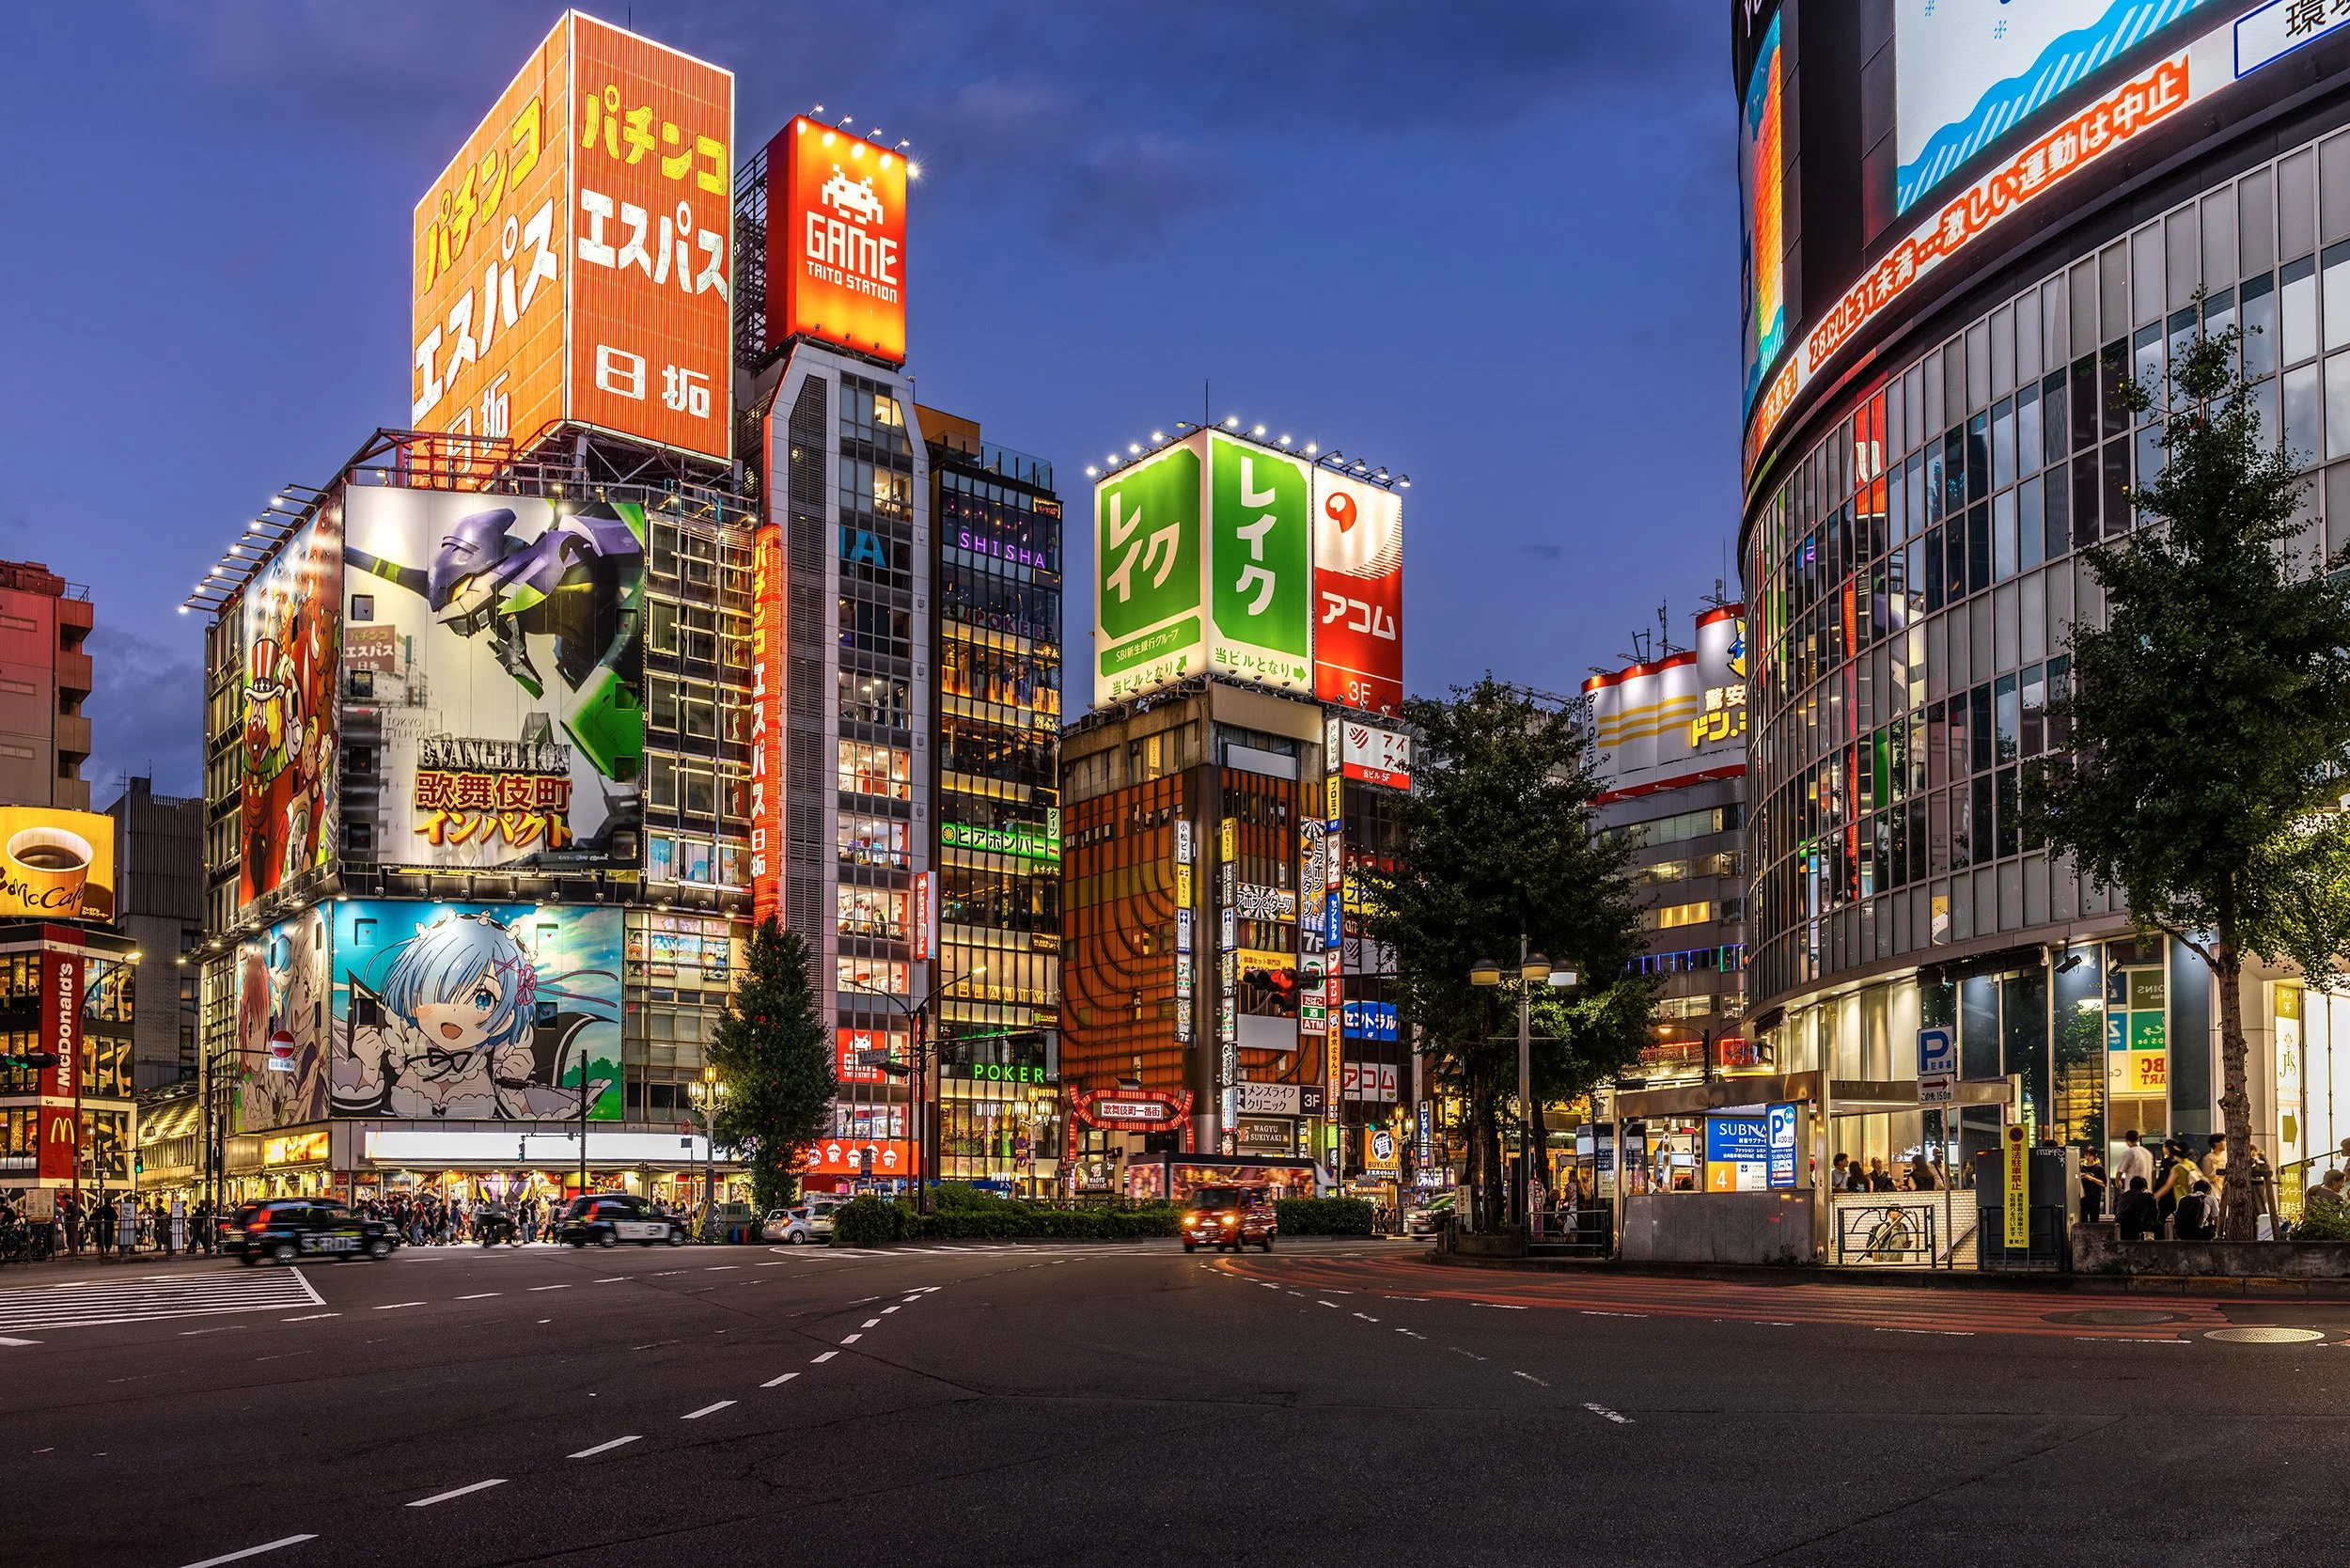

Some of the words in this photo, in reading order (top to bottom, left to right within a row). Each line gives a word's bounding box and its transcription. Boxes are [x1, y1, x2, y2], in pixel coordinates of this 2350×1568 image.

[580, 85, 728, 196] パチンコ
[423, 96, 540, 294] パチンコ
[578, 188, 728, 303] エスパス
[806, 212, 898, 286] GAME
[807, 259, 841, 286] TAITO
[846, 274, 897, 304] STATION
[413, 196, 557, 425] エスパス
[960, 532, 1045, 569] SHISHA
[1107, 492, 1180, 603] レイク
[1235, 456, 1277, 616] レイク
[754, 542, 768, 654] パチンコ
[1322, 590, 1396, 641] アコム
[346, 642, 394, 658] エスパス
[1215, 647, 1290, 678] 当ビルとなり
[1112, 661, 1173, 696] 当ビルとなり
[417, 738, 572, 774] EVANGELION
[752, 661, 766, 821] エスパス
[416, 771, 572, 811] 歌舞伎町
[1381, 773, 1390, 782] 5F
[414, 808, 572, 849] インパクト
[1049, 809, 1058, 838] ダーツ
[1180, 823, 1188, 860] 小松ビル
[1303, 932, 1324, 952] 7F
[959, 983, 1045, 1003] BEAUTY
[1304, 1020, 1324, 1030] ATM
[1344, 1010, 1397, 1030] セントラル
[1921, 1030, 1950, 1071] P
[974, 1064, 1044, 1083] POKER
[1344, 1068, 1396, 1090] アコム
[1247, 1085, 1296, 1099] メンズライフ
[1247, 1100, 1288, 1112] クリニック
[1304, 1094, 1321, 1107] 3F
[1103, 1104, 1162, 1118] 歌舞伎町一番街
[1250, 1133, 1282, 1142] SUKIYAKI
[1253, 1124, 1278, 1134] WAGYU
[1771, 1115, 1784, 1144] P
[1716, 1168, 1728, 1188] 4
[2011, 1143, 2022, 1191] 違法駐車禁止
